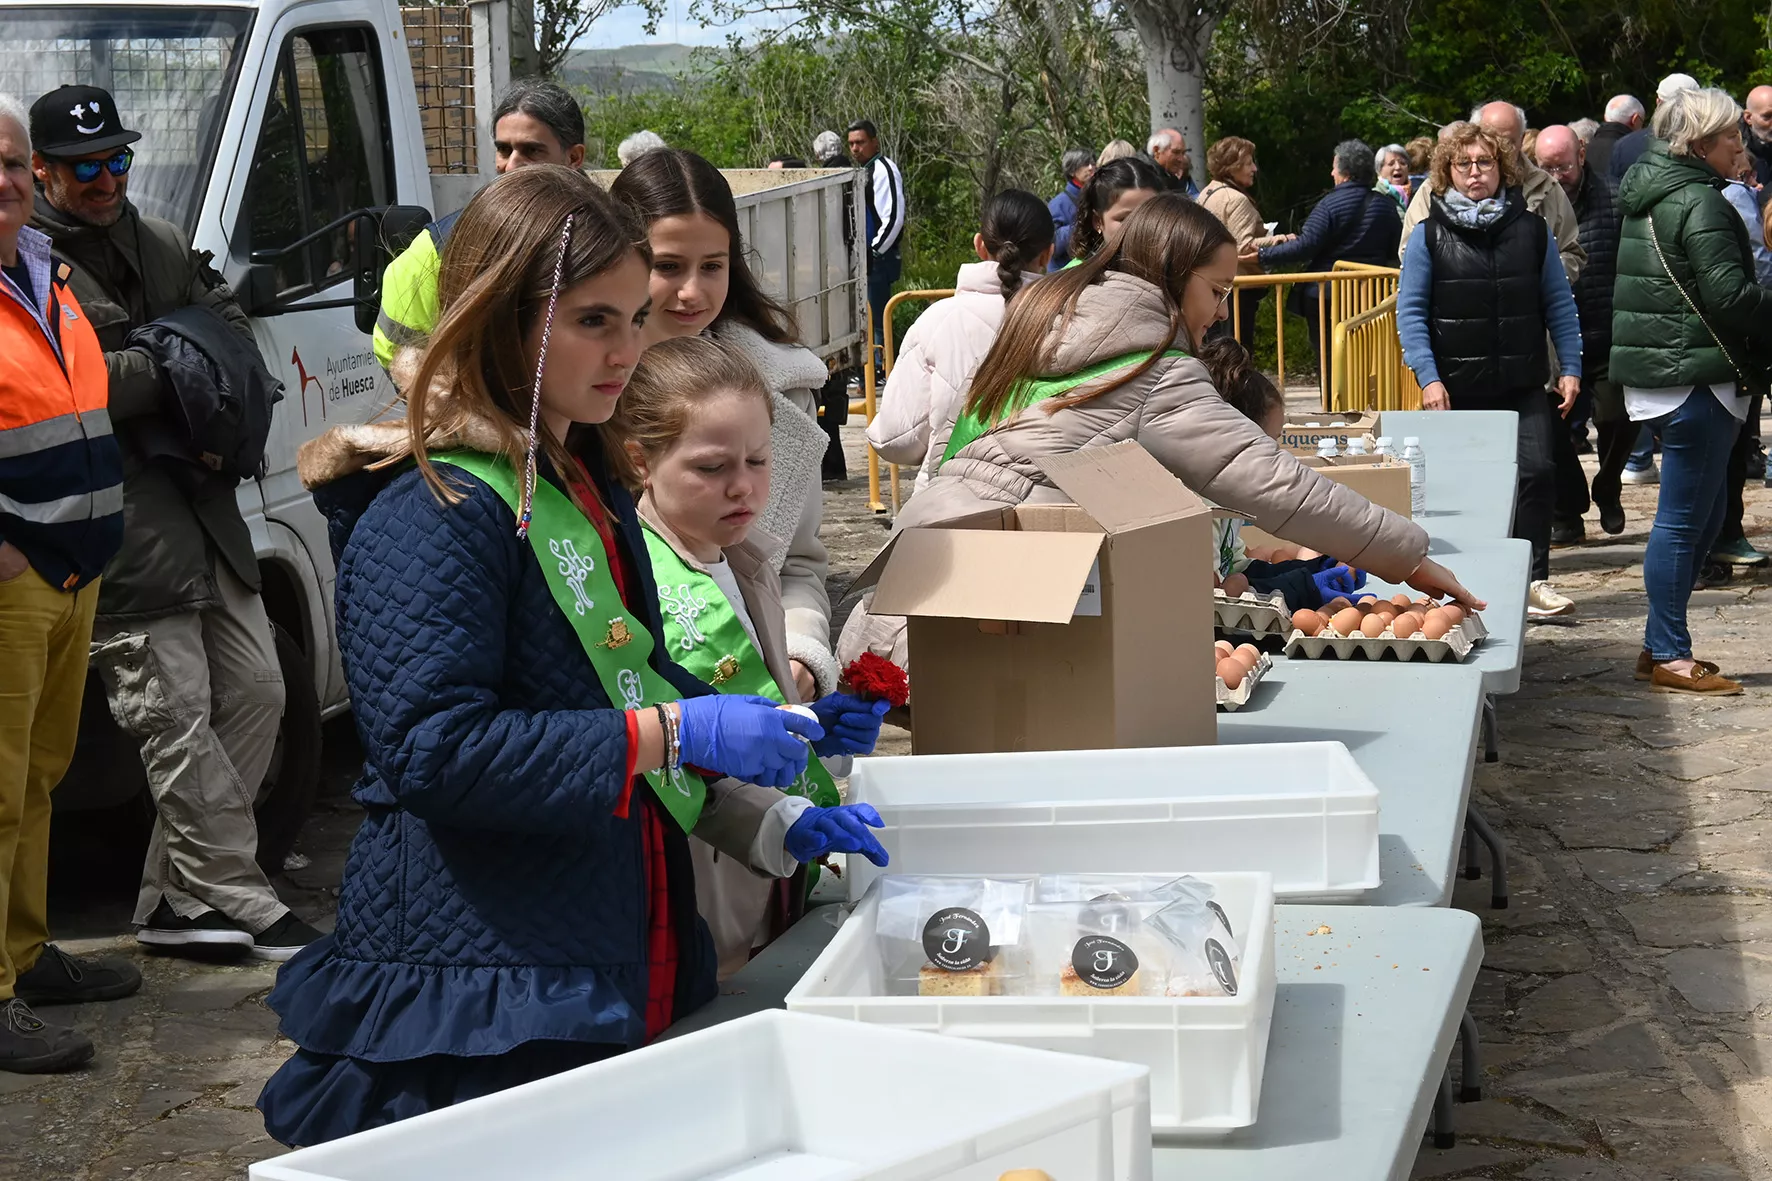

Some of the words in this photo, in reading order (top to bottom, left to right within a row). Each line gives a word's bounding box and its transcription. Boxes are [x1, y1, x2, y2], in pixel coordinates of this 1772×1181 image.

[326, 347, 378, 380] Ayuntamien
[329, 382, 340, 402] de
[341, 375, 375, 398] Huesca
[1281, 430, 1348, 448] iqueas
